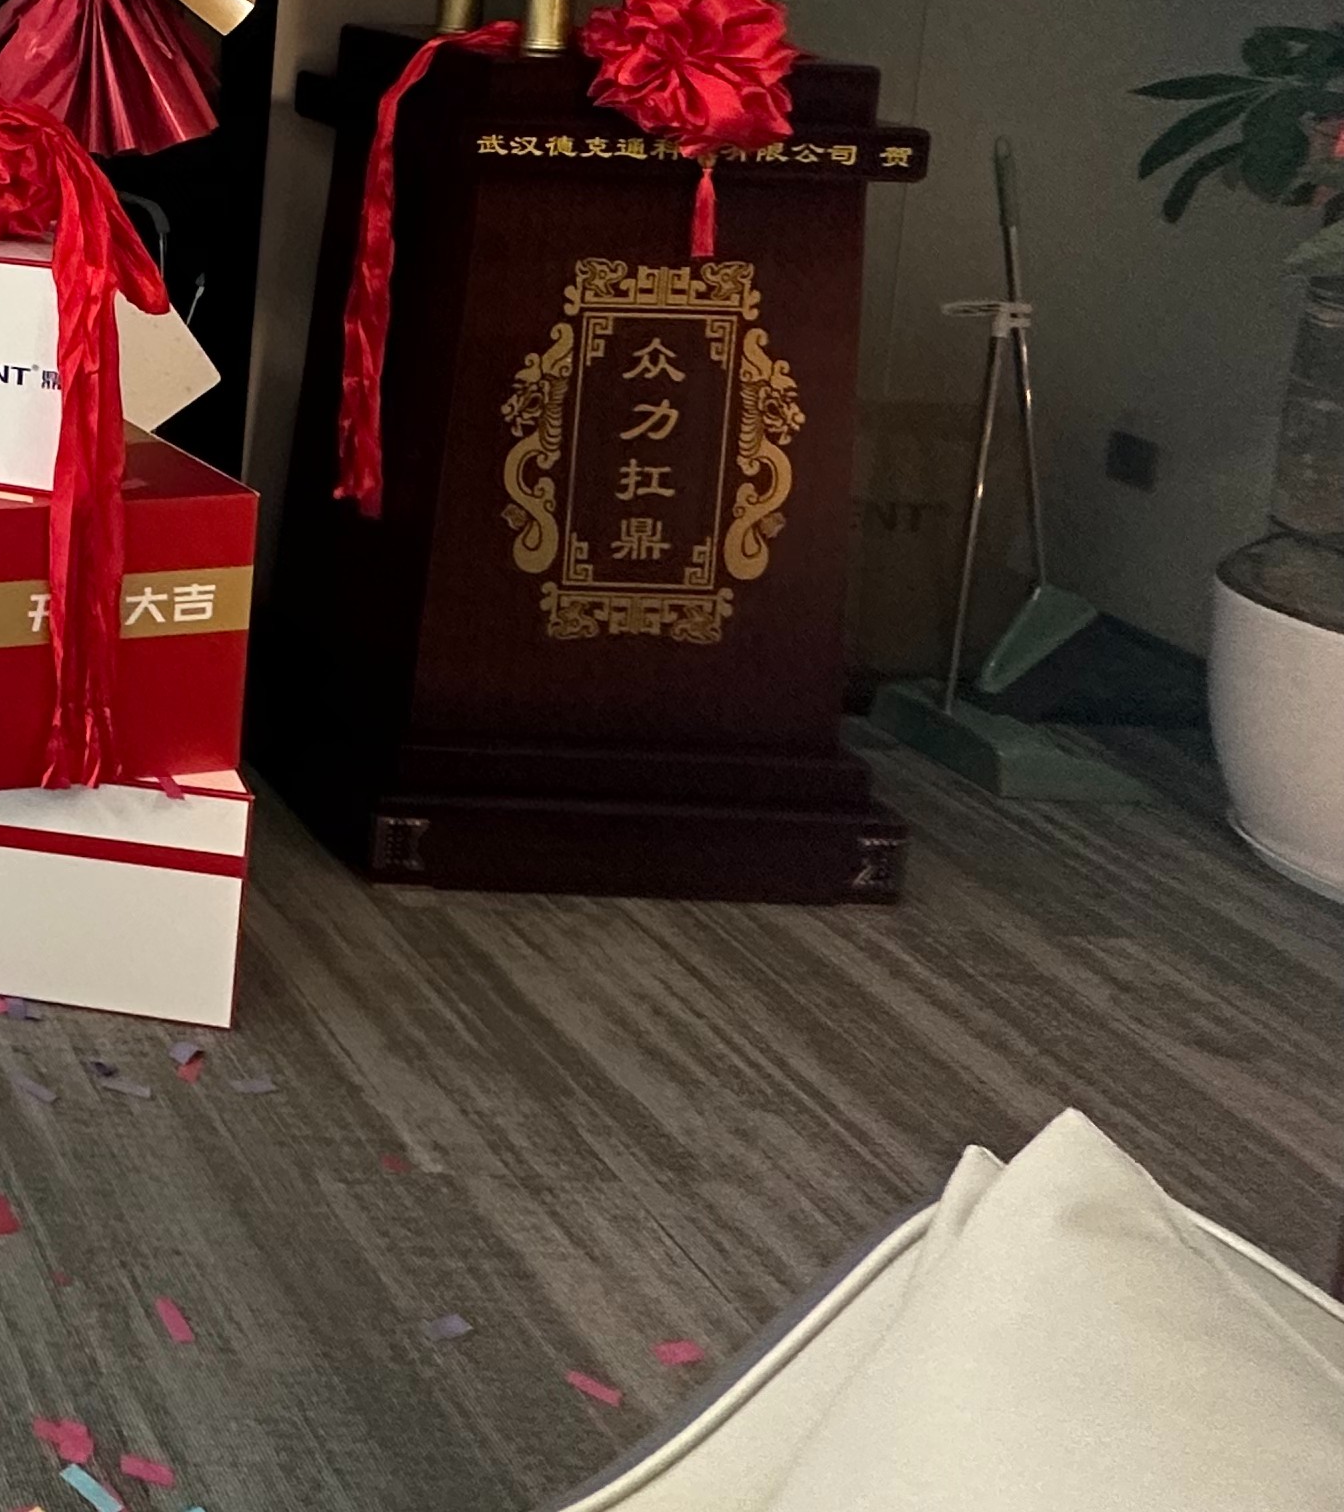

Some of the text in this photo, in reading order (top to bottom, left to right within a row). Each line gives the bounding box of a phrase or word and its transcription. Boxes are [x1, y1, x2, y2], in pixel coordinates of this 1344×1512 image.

[477, 134, 913, 168] 武汉德克通科有限公司 贺
[41, 369, 62, 391] 鼎
[611, 337, 686, 560] 众力扛鼎
[27, 583, 217, 633] 开大吉
